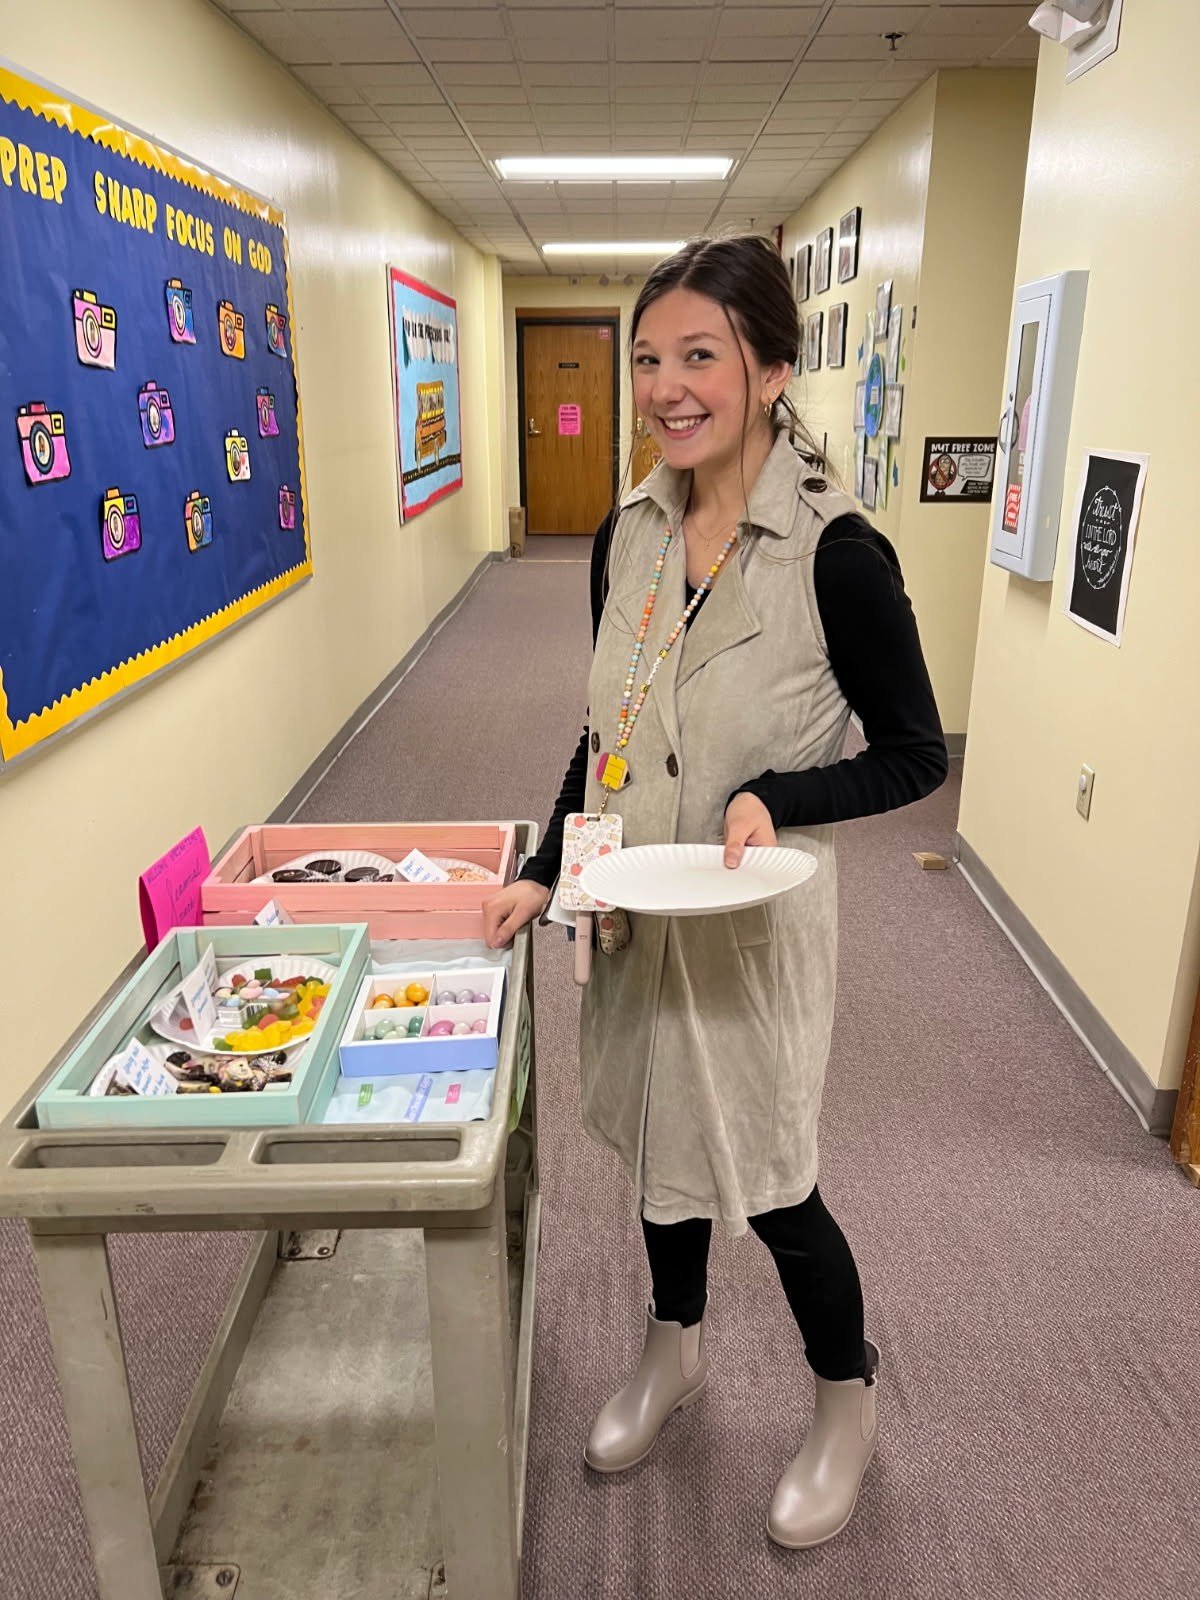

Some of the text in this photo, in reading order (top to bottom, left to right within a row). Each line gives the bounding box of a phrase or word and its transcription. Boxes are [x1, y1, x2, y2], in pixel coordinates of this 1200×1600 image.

[0, 136, 272, 275] PREP SHARP FOCUS ON GOD
[931, 443, 995, 453] NUT FREE ZONE
